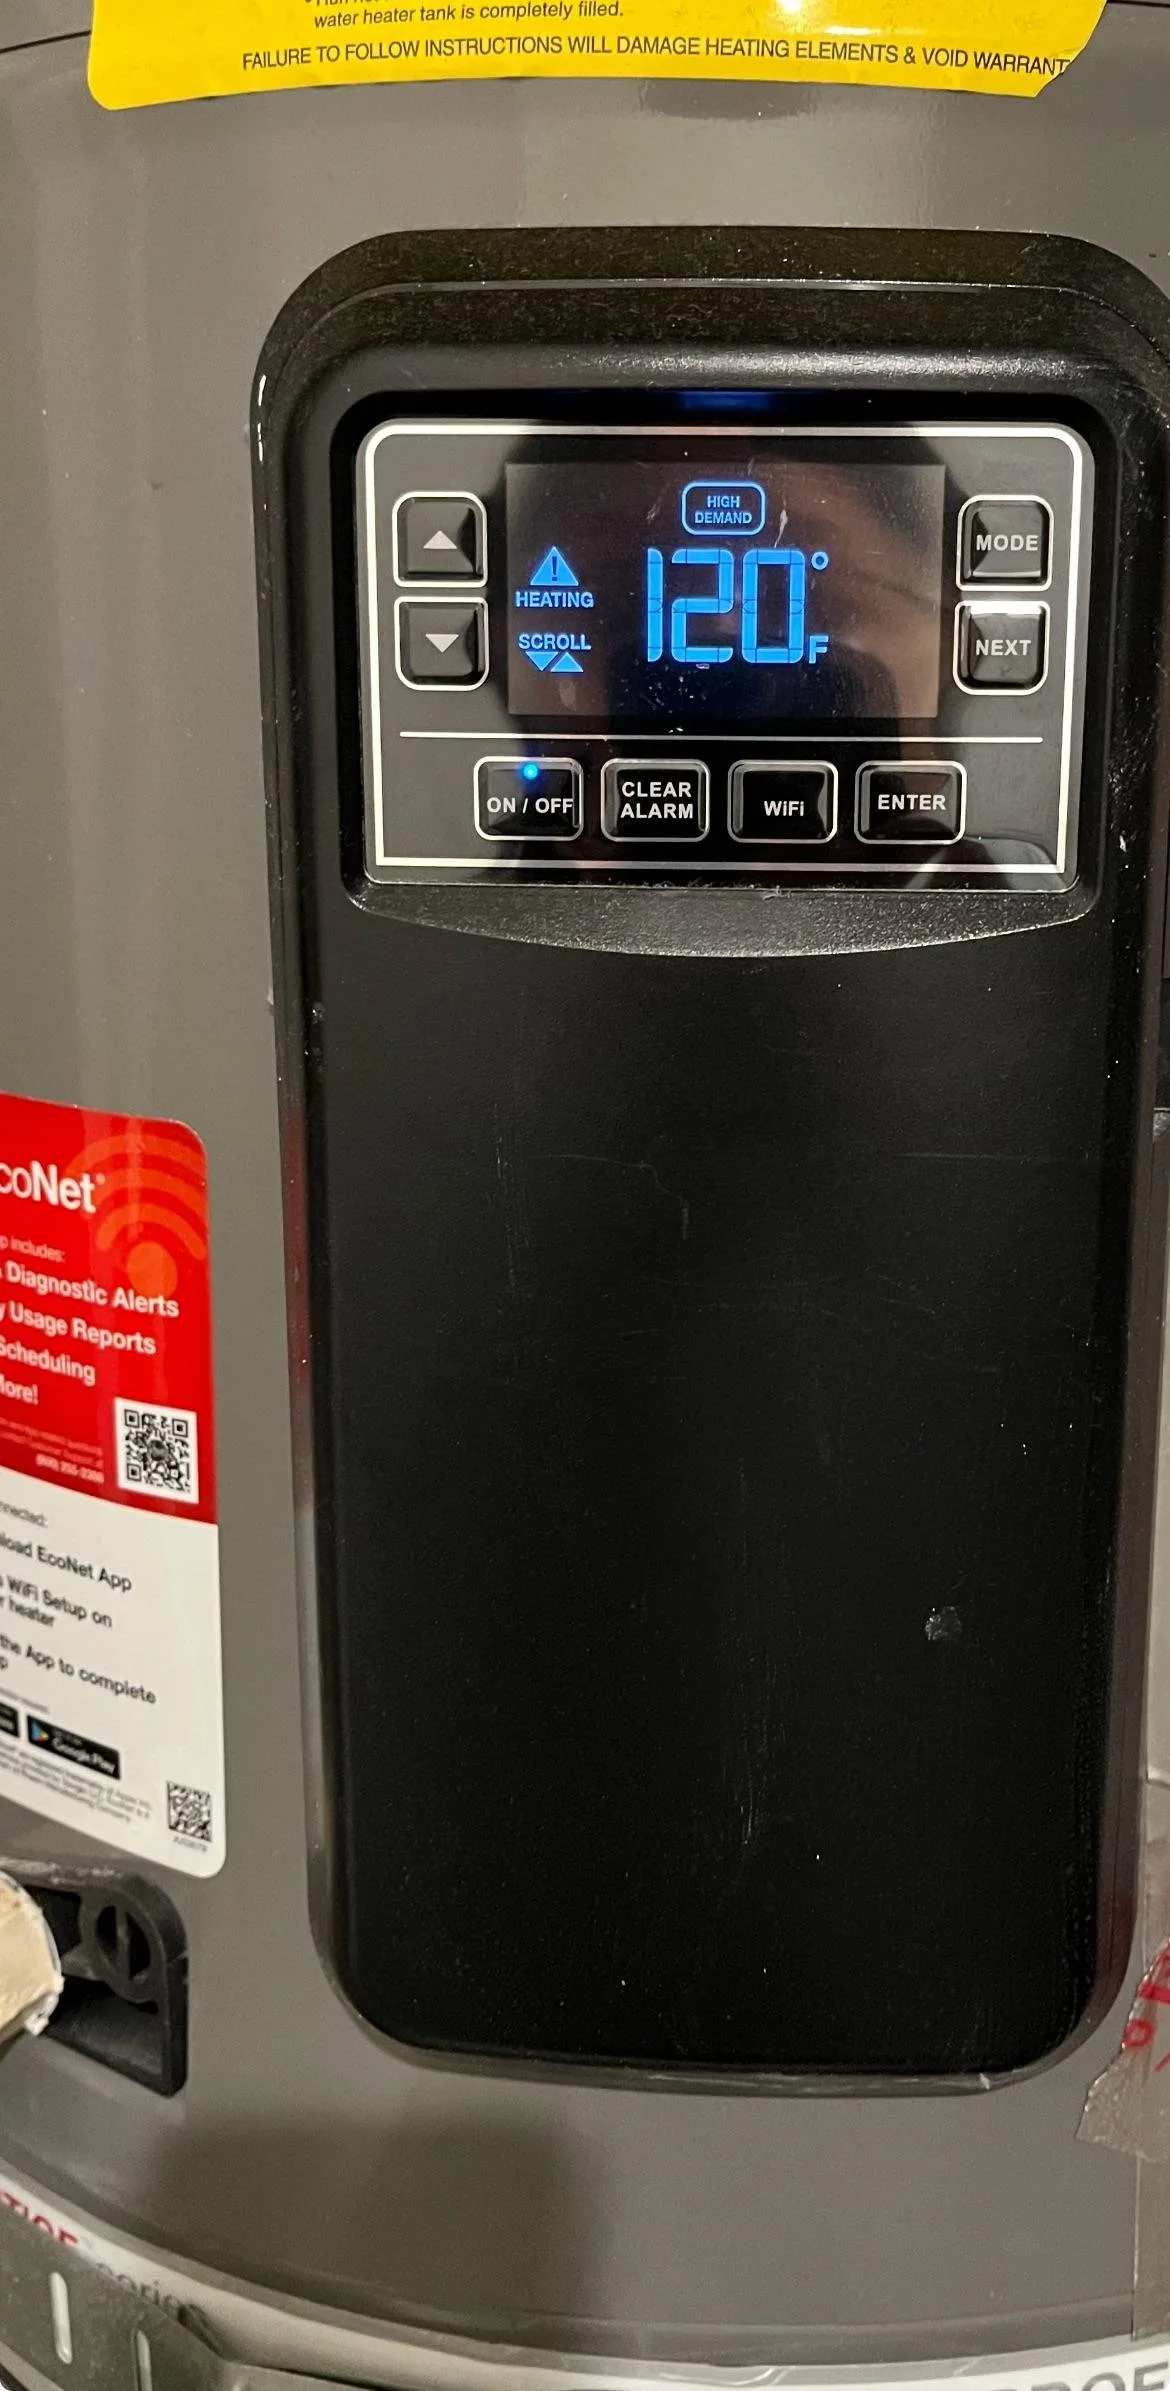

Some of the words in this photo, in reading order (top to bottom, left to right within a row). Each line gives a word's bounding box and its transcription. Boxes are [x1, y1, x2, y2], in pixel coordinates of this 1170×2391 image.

[315, 12, 359, 29] water
[363, 8, 416, 25] heater
[420, 5, 456, 21] tank
[461, 5, 475, 20] is
[480, 1, 573, 22] completely
[578, 0, 624, 17] filled.
[242, 47, 311, 71] FAILURE
[316, 45, 341, 63] TO
[345, 40, 420, 62] FOLLOW
[425, 36, 562, 58] INSTRUCTIONS
[568, 36, 612, 54] WILL
[616, 36, 700, 55] DAMAGE
[705, 38, 790, 58] HEATING
[795, 40, 899, 64] ELEMENTS
[903, 46, 916, 65] &
[922, 48, 969, 67] VOID
[707, 495, 740, 508] HIGH
[694, 512, 753, 524] DEMAND
[975, 535, 1038, 552] MODE
[515, 591, 594, 608] HEATING
[518, 634, 592, 650] SCROLL
[975, 638, 1031, 657] NEXT
[622, 781, 692, 798] CLEAR
[487, 797, 516, 814] ON
[535, 797, 574, 814] OFF
[620, 802, 694, 820] ALARM
[764, 800, 805, 817] WiFi
[878, 794, 946, 811] ENTER
[6, 1260, 108, 1306] Diagnostic
[113, 1287, 179, 1317] Alerts
[9, 1302, 67, 1337] Usage
[72, 1317, 156, 1355] Reports
[0, 1334, 96, 1387] Scheduling
[37, 1545, 94, 1580] EcoNet
[98, 1568, 132, 1593] App
[6, 1575, 39, 1601] WiFi
[43, 1589, 87, 1621] Setup
[92, 1610, 113, 1628] on
[9, 1597, 55, 1628] heater
[0, 1633, 21, 1655] the
[26, 1645, 55, 1671] App
[58, 1657, 74, 1677] to
[79, 1667, 156, 1704] complete
